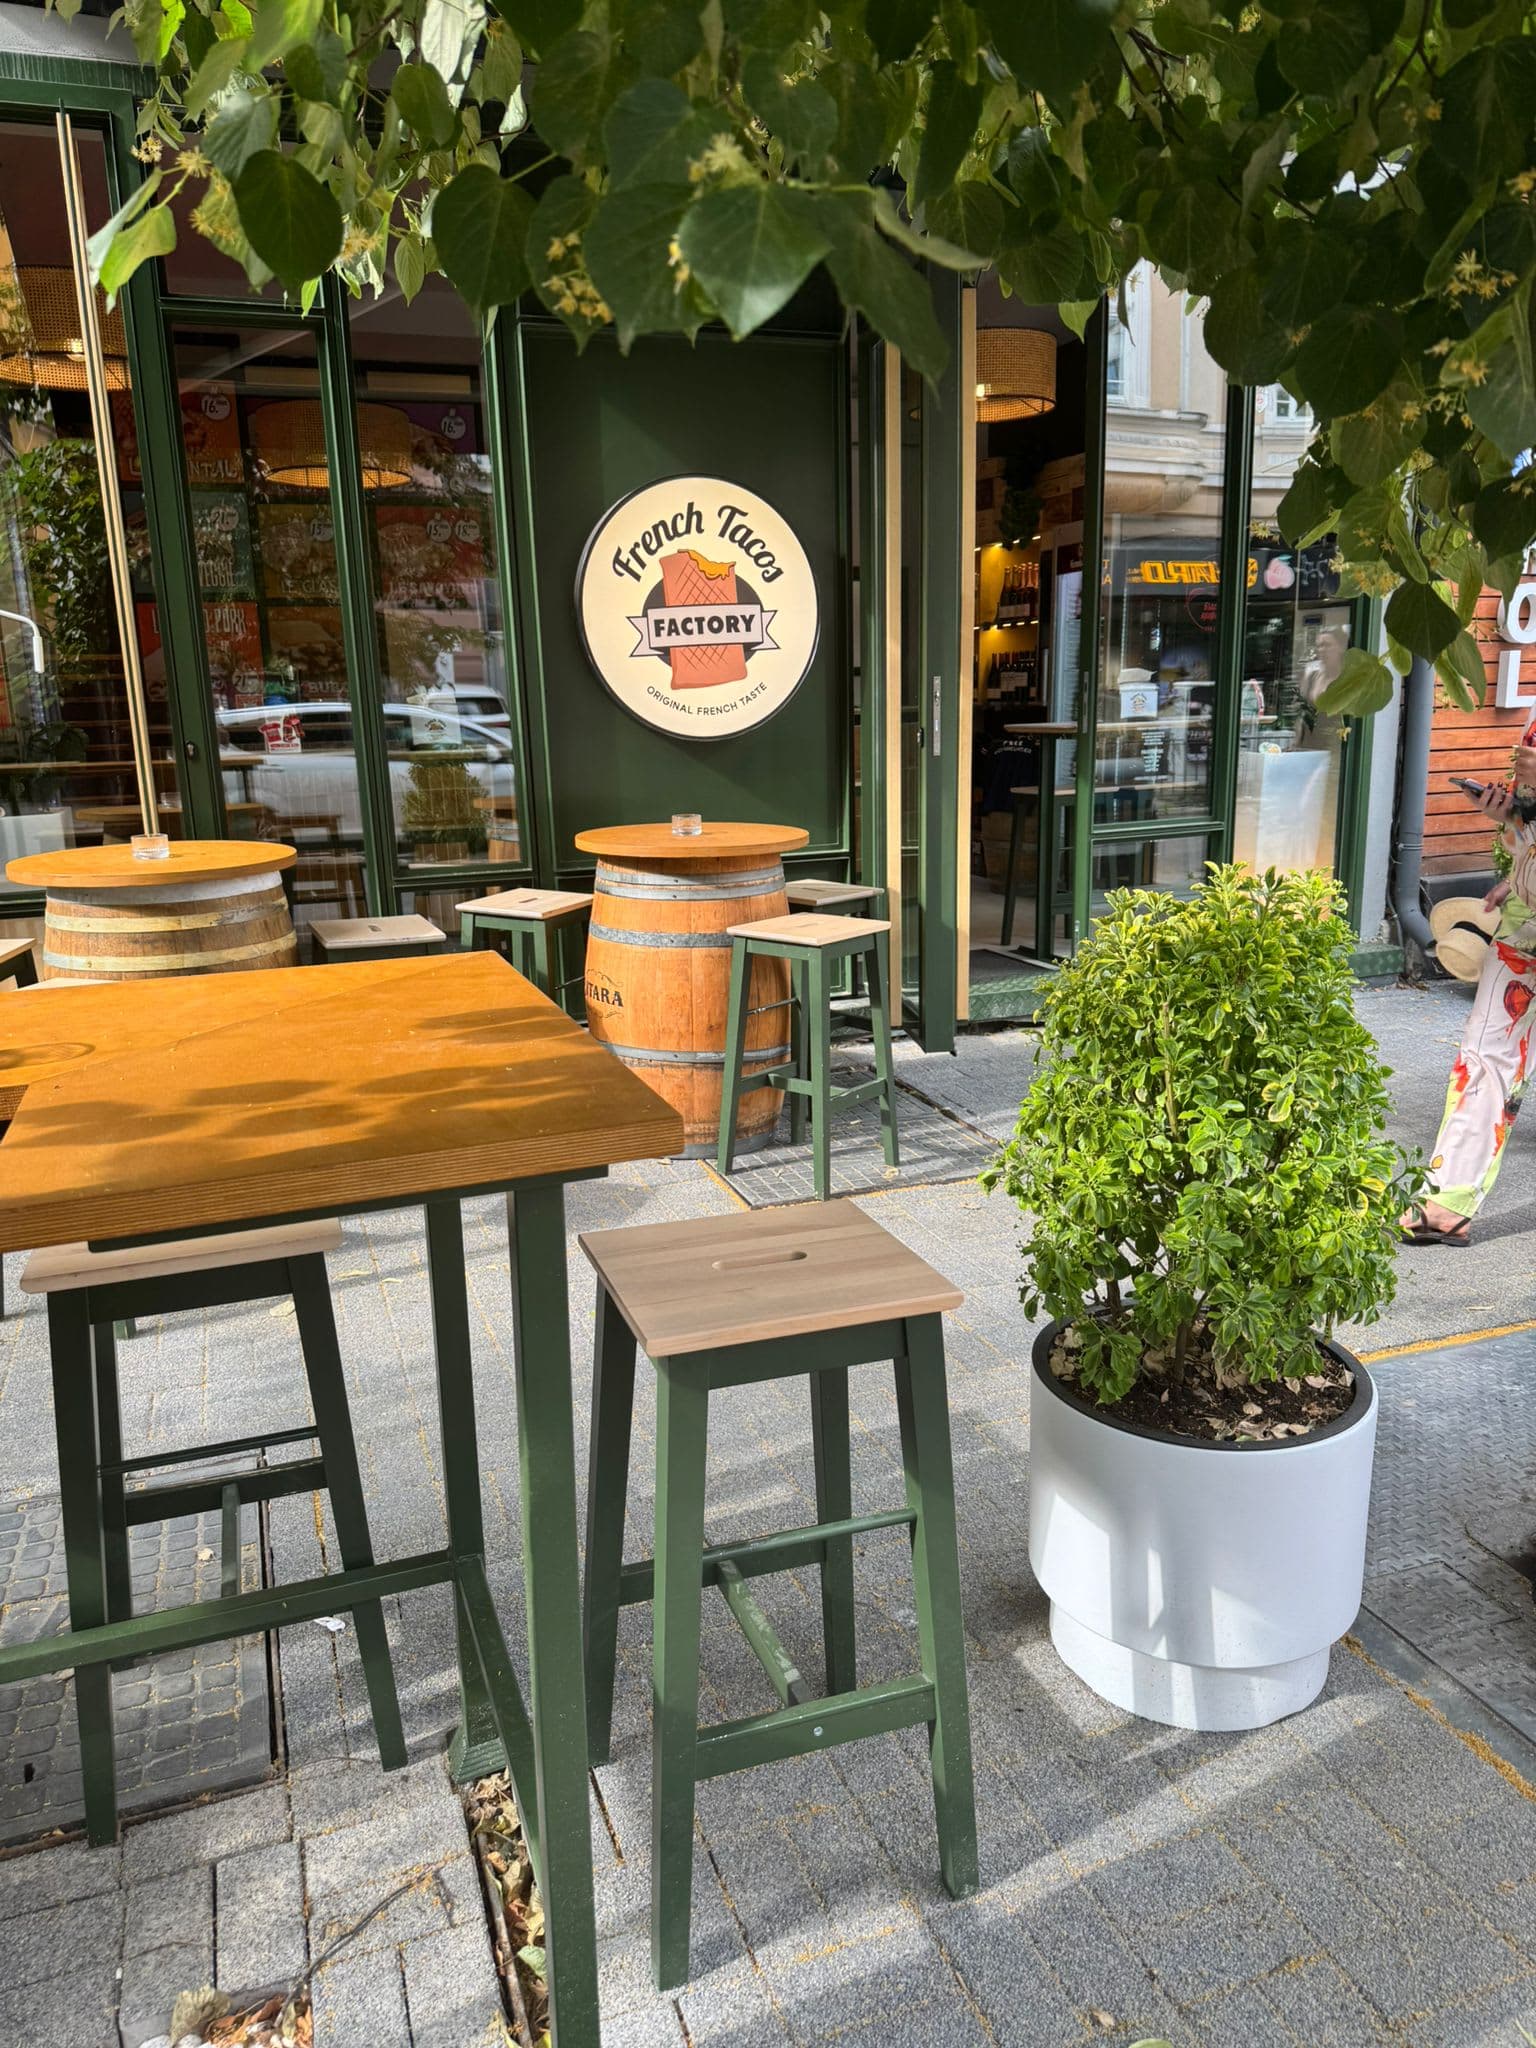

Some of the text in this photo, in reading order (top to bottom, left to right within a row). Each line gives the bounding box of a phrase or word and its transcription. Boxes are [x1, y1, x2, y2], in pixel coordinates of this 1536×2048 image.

[612, 502, 784, 583] French Tacos
[654, 614, 756, 638] FACTORY
[646, 682, 768, 716] ORIGINAL FRENCH TASTE
